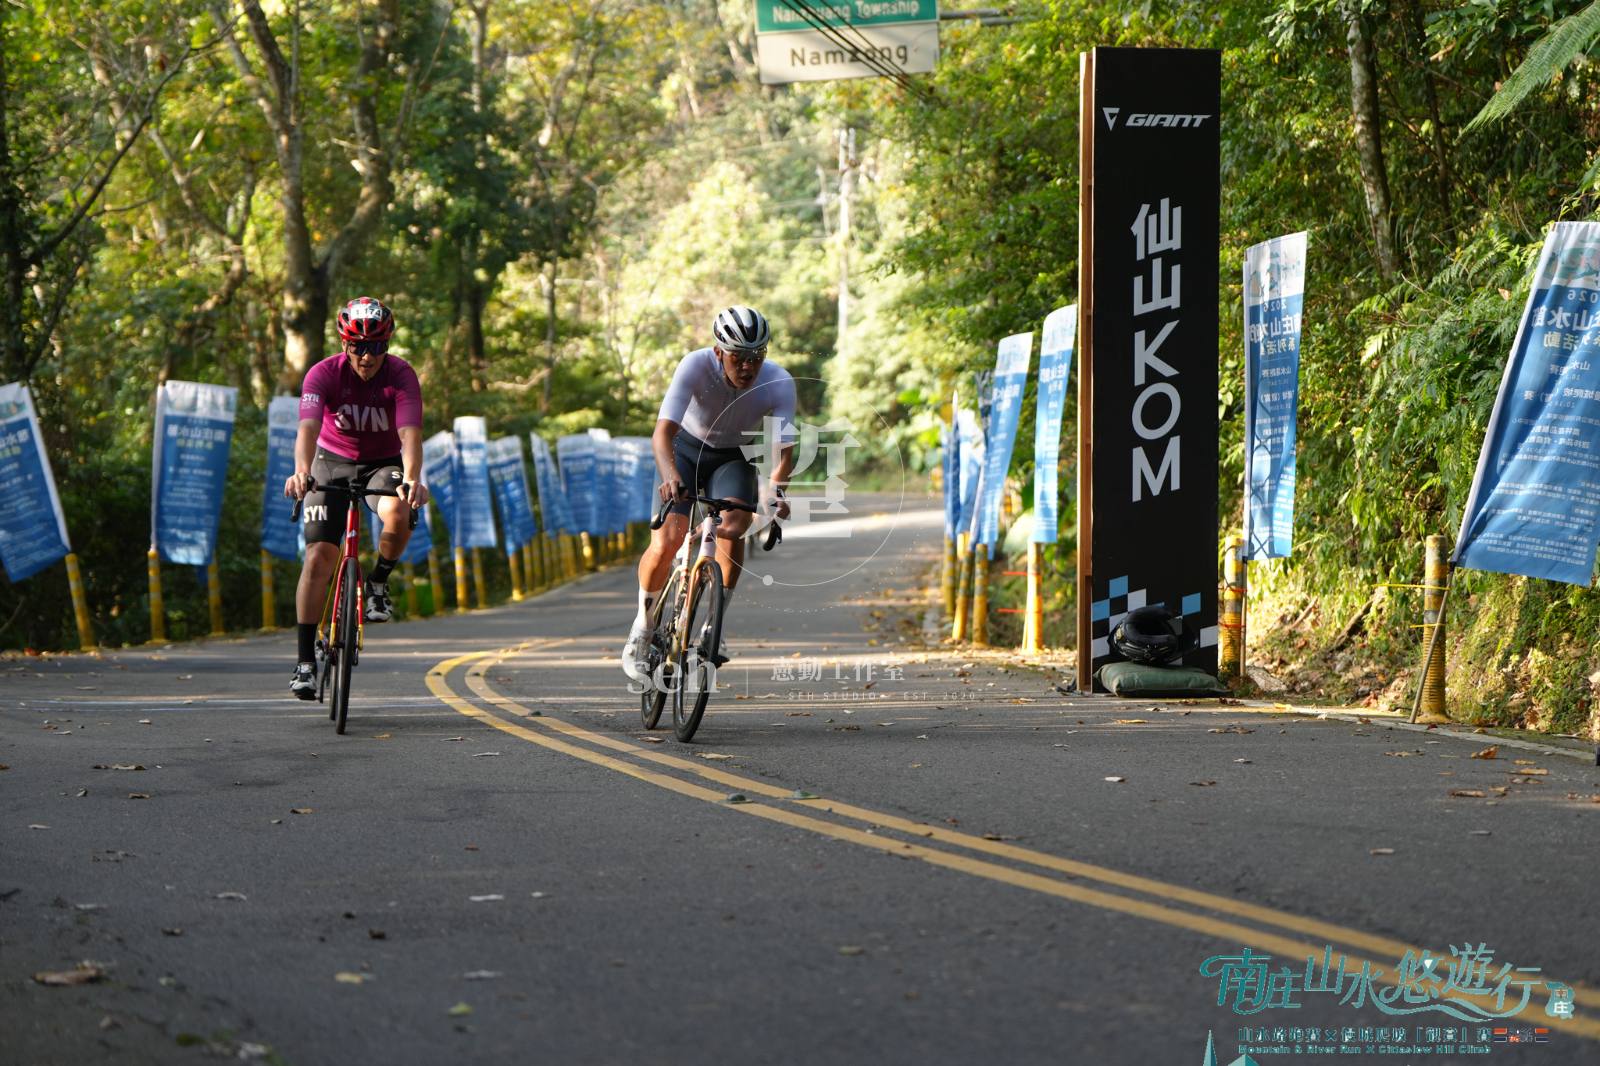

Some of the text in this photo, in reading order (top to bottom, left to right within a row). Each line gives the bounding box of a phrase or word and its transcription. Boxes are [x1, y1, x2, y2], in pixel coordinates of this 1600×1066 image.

[855, 0, 920, 19] Township
[1125, 113, 1213, 128] GIANT
[302, 393, 320, 403] SYN
[334, 404, 390, 433] SYN
[303, 504, 328, 524] SYN
